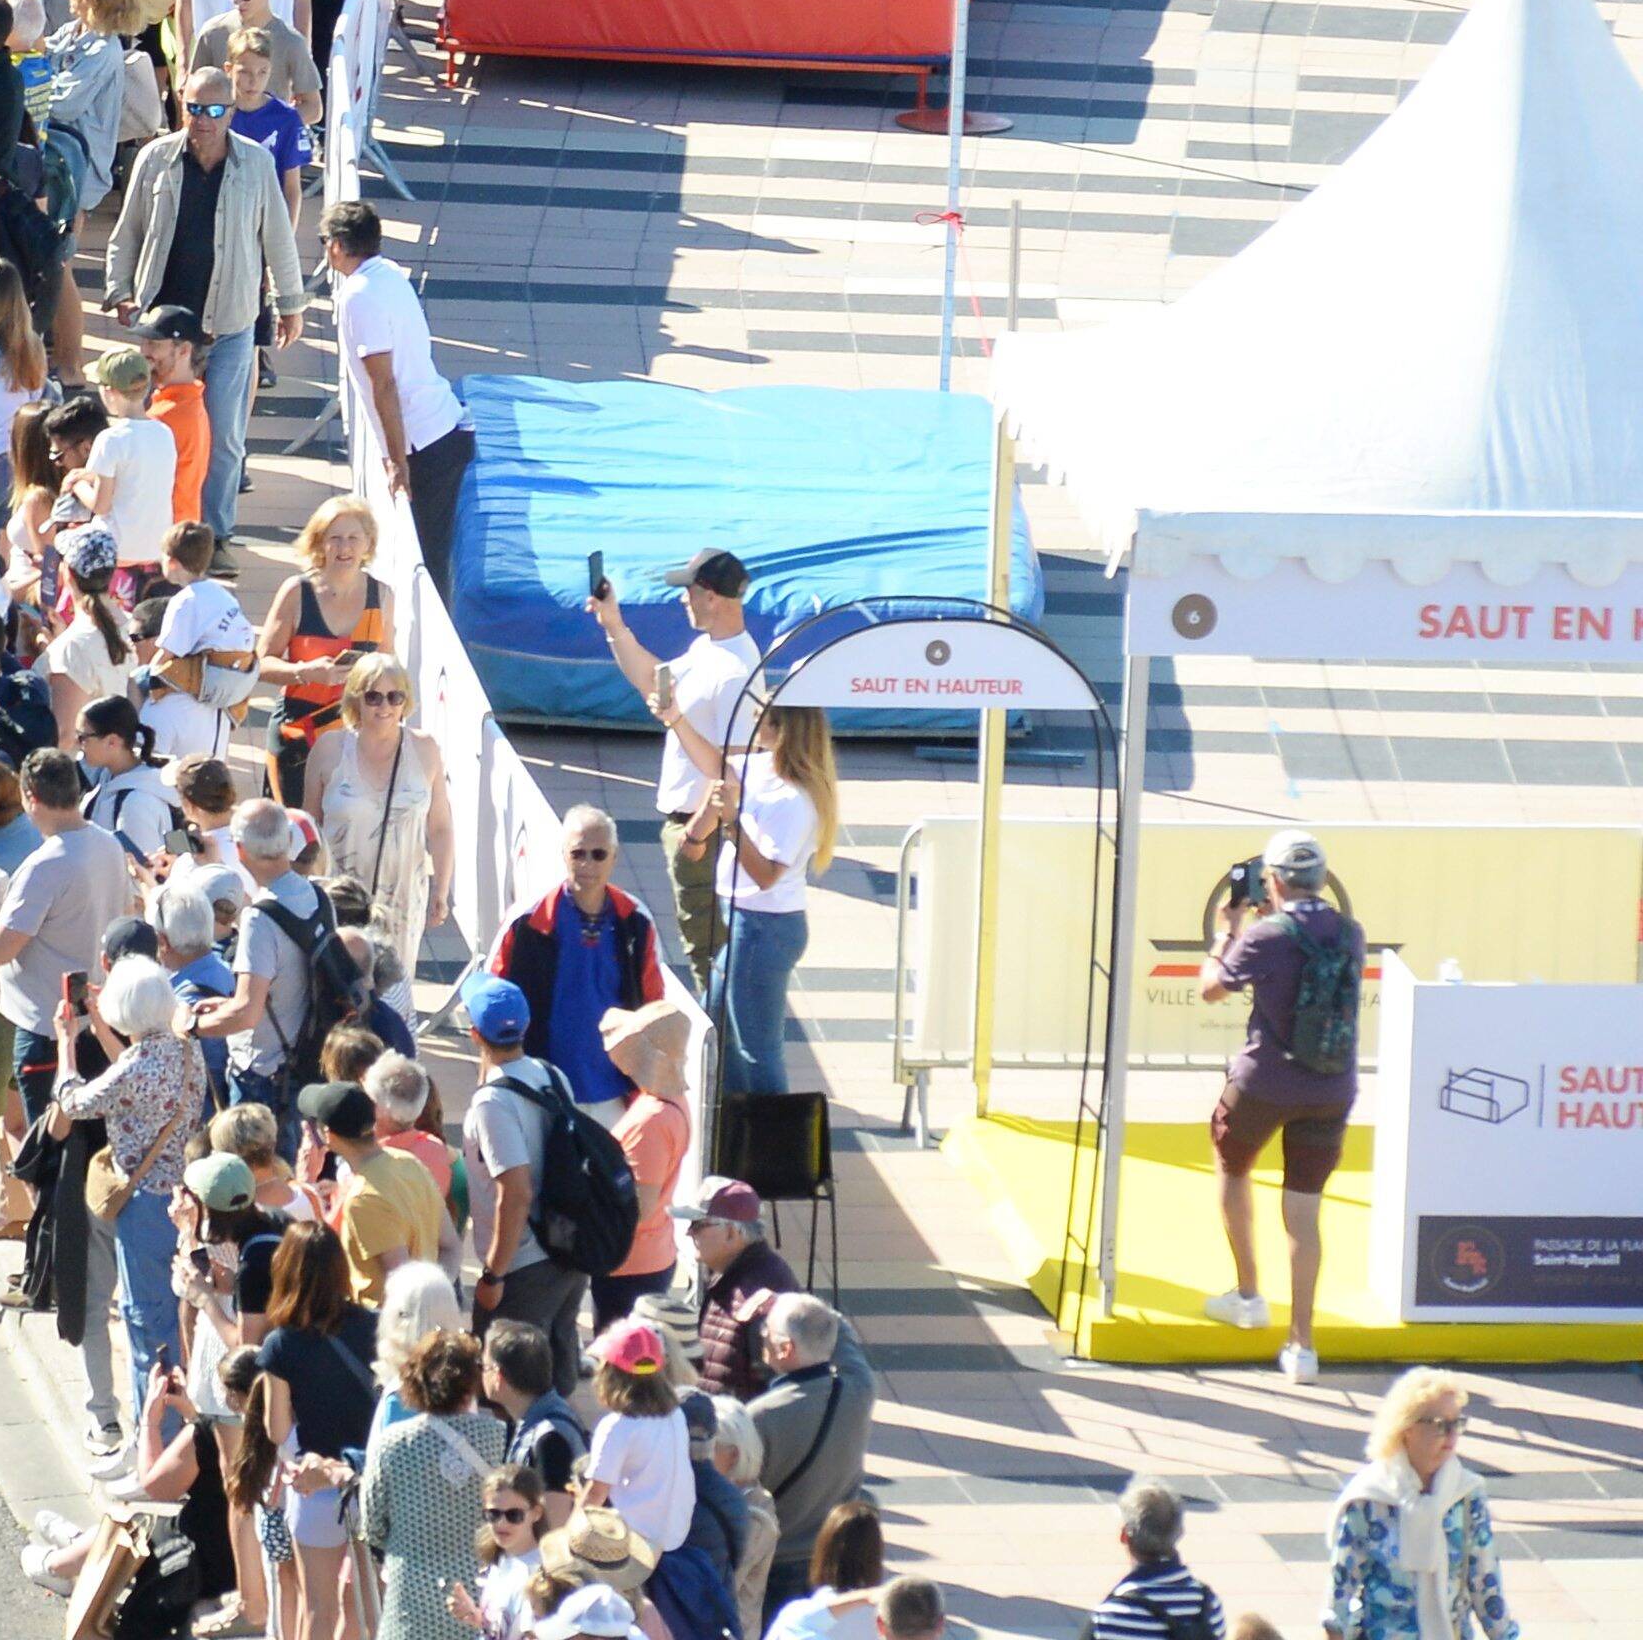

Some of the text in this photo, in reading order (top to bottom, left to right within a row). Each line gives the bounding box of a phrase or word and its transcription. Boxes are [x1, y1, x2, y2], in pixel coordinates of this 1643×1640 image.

[1189, 610, 1202, 625] 6
[1418, 603, 1534, 640] SAUT
[1551, 606, 1613, 642] EN
[934, 648, 944, 660] 6
[850, 677, 1023, 696] SAUT EN HAUTEUR
[1146, 988, 1196, 1007] VILLE
[1534, 1239, 1584, 1251] PASSAGE
[1586, 1239, 1603, 1251] DE
[1605, 1240, 1619, 1251] LA
